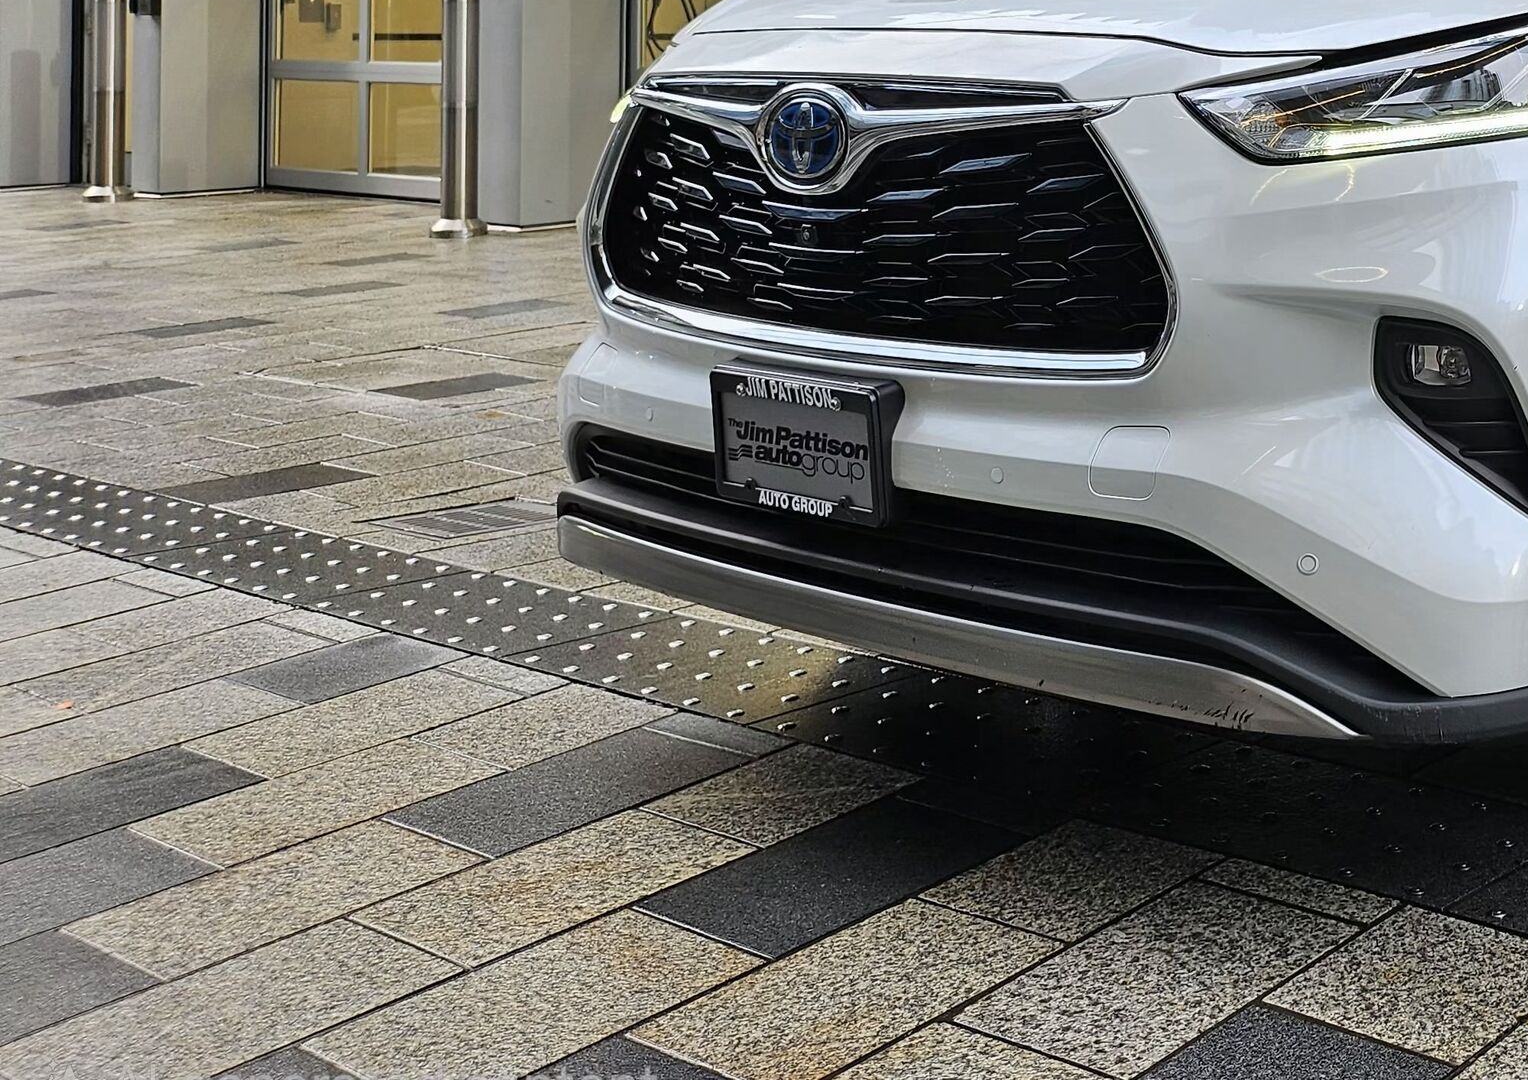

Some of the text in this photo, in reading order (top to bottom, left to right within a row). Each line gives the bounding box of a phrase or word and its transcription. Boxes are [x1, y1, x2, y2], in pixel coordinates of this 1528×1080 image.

[745, 376, 833, 409] JIM PATTISON
[759, 489, 834, 518] AUTO GROUP
